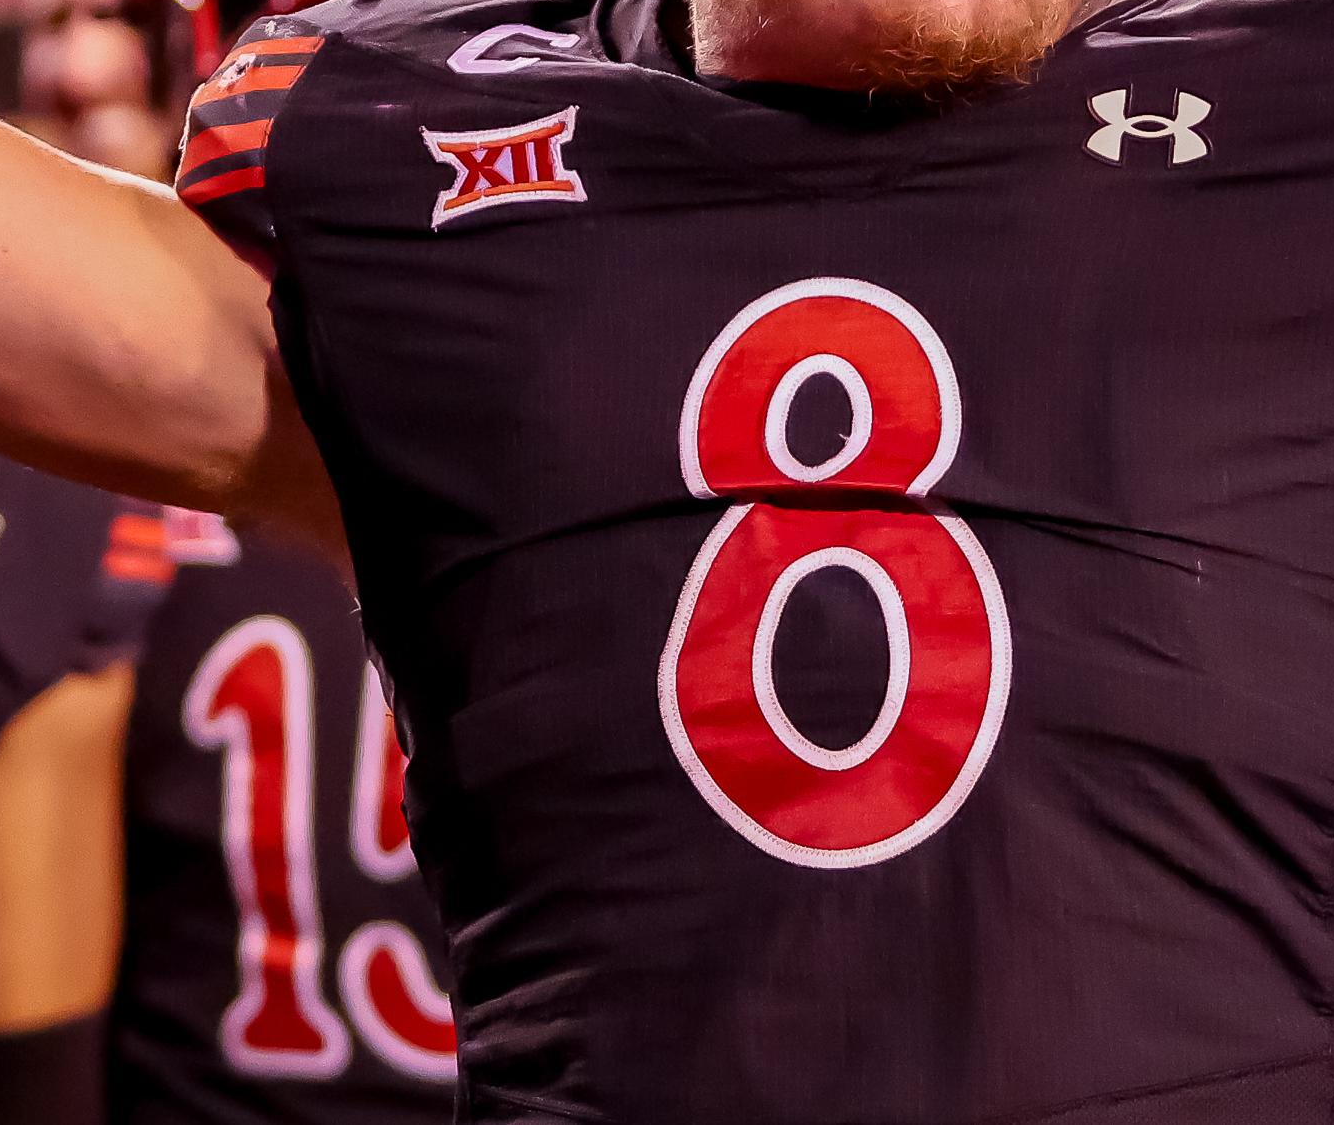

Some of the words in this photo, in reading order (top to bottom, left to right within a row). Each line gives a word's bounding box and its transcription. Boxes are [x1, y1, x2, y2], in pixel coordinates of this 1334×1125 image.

[446, 24, 581, 74] C
[433, 118, 577, 213] XII
[658, 277, 1013, 869] 8
